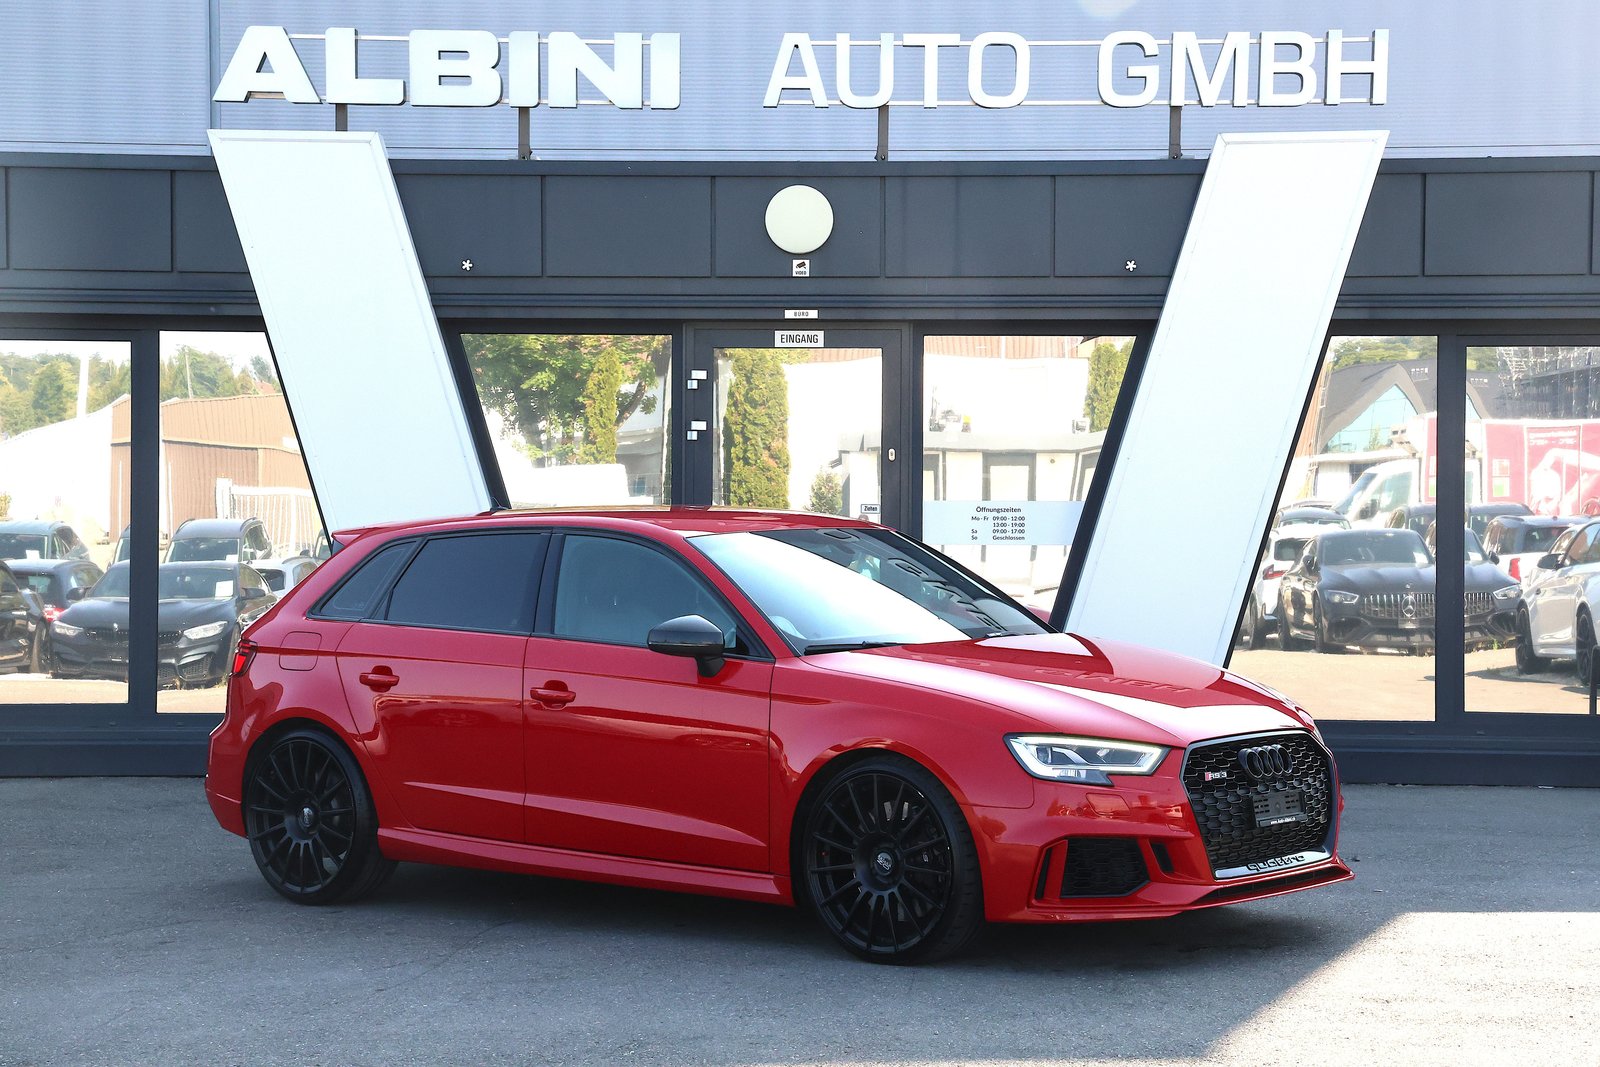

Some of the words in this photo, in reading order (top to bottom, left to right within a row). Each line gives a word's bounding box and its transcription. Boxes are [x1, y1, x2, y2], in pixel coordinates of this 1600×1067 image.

[212, 25, 682, 110] ALBINI
[763, 31, 1031, 109] AUTO
[1097, 28, 1389, 109] GMBH
[780, 334, 818, 344] EINGANG
[976, 506, 1022, 514] Öffnungszeiten
